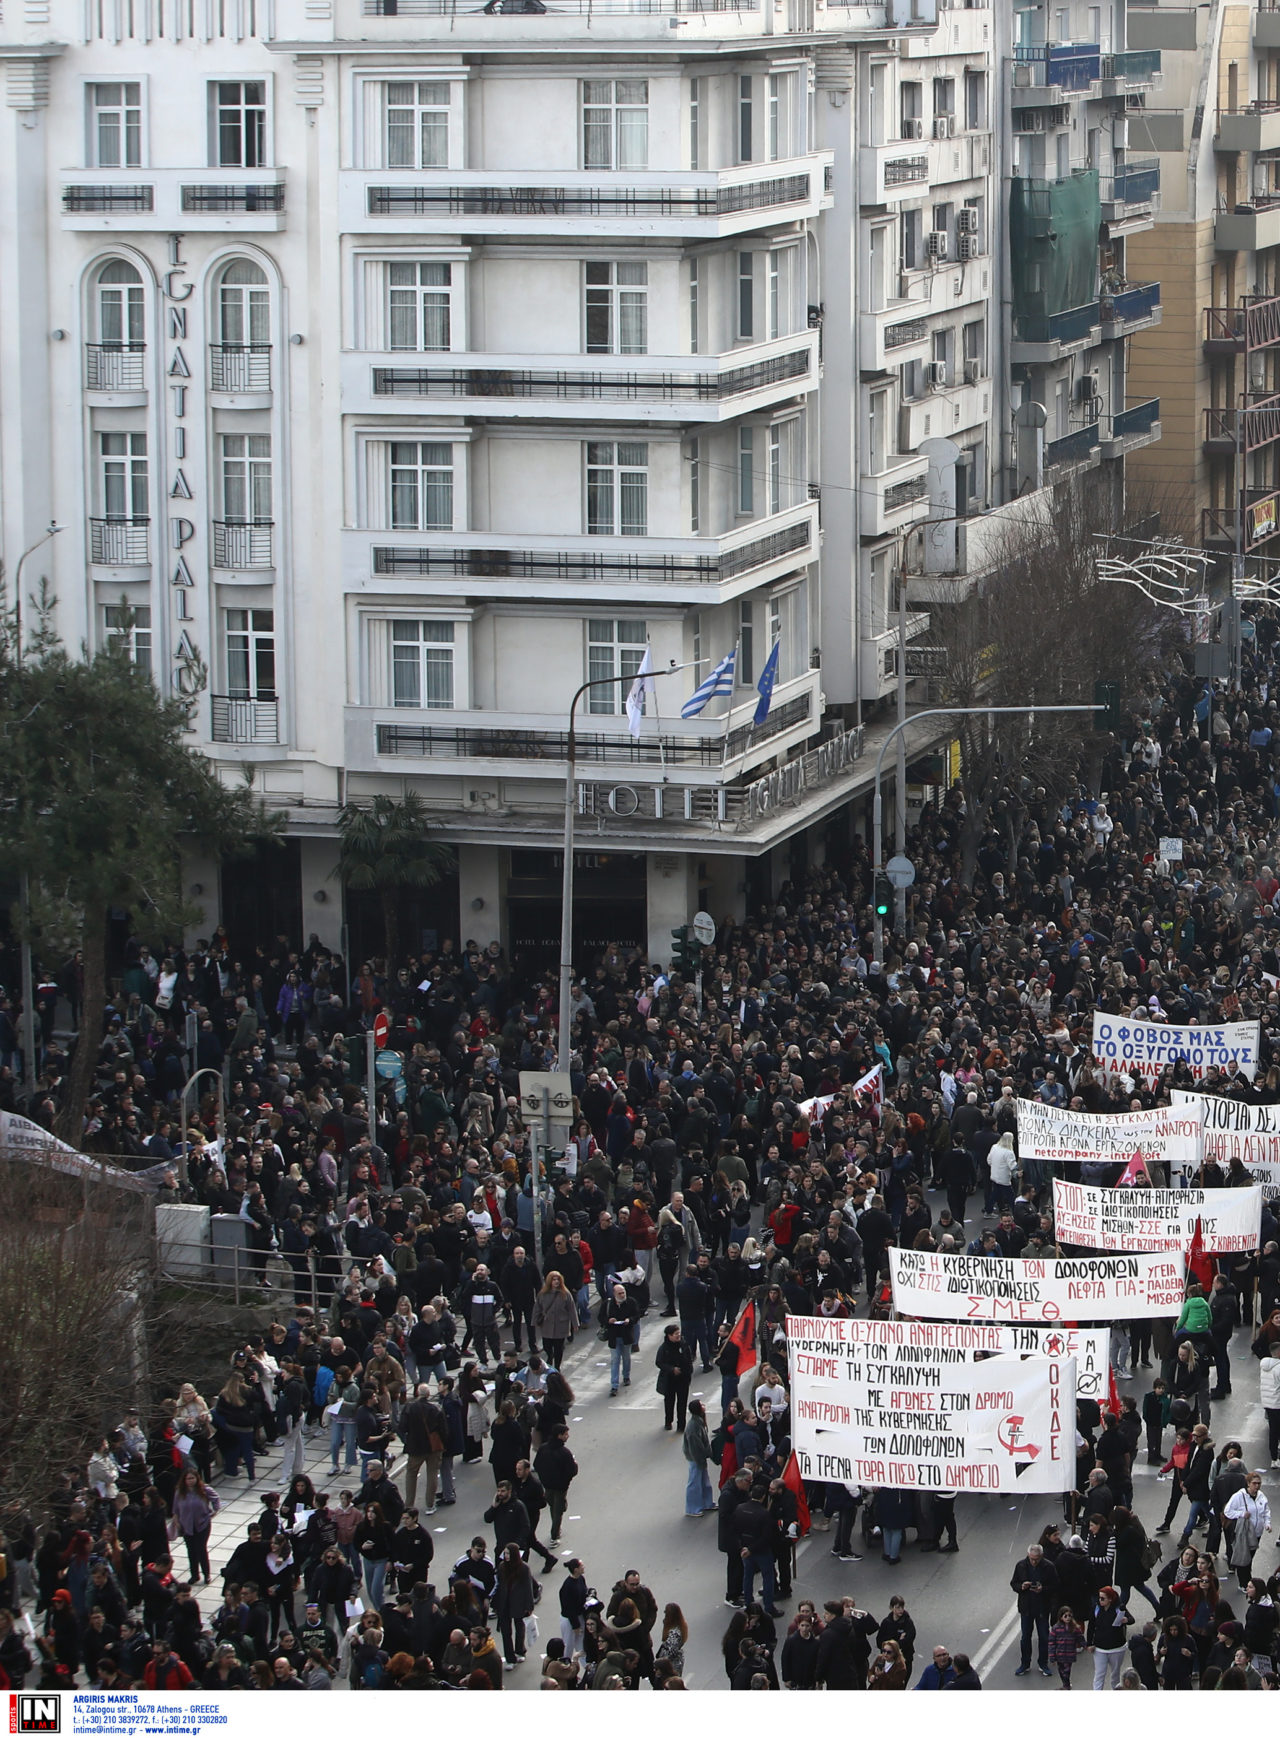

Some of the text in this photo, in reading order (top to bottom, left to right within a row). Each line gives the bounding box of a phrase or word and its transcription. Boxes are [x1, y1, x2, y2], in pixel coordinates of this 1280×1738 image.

[162, 233, 195, 499] EGNATIA
[1100, 1024, 1112, 1040] Ο
[1118, 1026, 1184, 1045] ΦΟΒΟΣ
[1190, 1031, 1225, 1046] ΜΑΣ
[1094, 1040, 1117, 1057] ΤΟ
[1122, 1043, 1203, 1065] ΟΞΥΓΟΝΟ
[1030, 1103, 1050, 1118] ΜΗΝ
[1059, 1123, 1121, 1140] ΔΙΑΡΚΕΙΑΣ
[1155, 1121, 1202, 1139] ΑΝΑΤΡΟΠΗ
[1035, 1149, 1101, 1160] netcompany
[1060, 1136, 1090, 1150] ΑΓΩΝΑ
[1243, 1135, 1265, 1163] ΔΕΝ
[1087, 1192, 1097, 1202] ΣΕ
[1057, 1211, 1097, 1231] ΑΥΞΗΣΕΙΣ
[1168, 1224, 1181, 1234] ΓΙΑ
[1089, 1206, 1179, 1219] ΣΕ ΙΔΙΩΤΙΚΟΠΟΙΗΣΕΙΣ
[900, 1253, 1139, 1281] ΚΑΤΩ Η ΚΥΒΕΡΝΗΣΗ ΤΩΝ ΔΟΛΟΦΟΝΩΝ
[1147, 1264, 1177, 1278] ΥΓΕΙΑ
[897, 1271, 916, 1288] ΟΧΙ
[918, 1273, 942, 1293] ΣΤΙΣ
[947, 1276, 1042, 1302] ΙΔΙΩΤΙΚΟΠΟΙΗΣΕΙΣ
[1068, 1280, 1106, 1300] ΛΕΦΤΑ
[1147, 1278, 1184, 1291] ΠΑΙΔΕΙΑ
[786, 1317, 1038, 1350] ΠΑΙΡΝΟΥΜΕ ΟΞΥΓΟΝΟ ΑΝΑΤΡΕΠΟΝΤΑΣ ΤΗΝ
[797, 1354, 940, 1386] ΣΠΑΜΕ ΤΗ ΣΥΓΚΑΛΥΨΗ
[868, 1390, 1013, 1411] ΜΕ ΑΓΩΝΕΣ ΣΤΟΝ ΔΡΟΜΟ
[1049, 1363, 1061, 1460] ΟΚΔΕ
[798, 1400, 953, 1431] ΑΝΑΤΡΟΠΗ ΤΗΣ ΚΥΒΕΡΝΗΣΗΣ
[863, 1433, 965, 1458] ΤΩΝ ΔΟΛΟΦΟΝΩΝ
[798, 1451, 1000, 1488] ΤΑ ΤΡΕΝΑ ΤΩΡΑ ΠΙΣΩ ΣΤΟ ΔΗΜΟΣΙΟ
